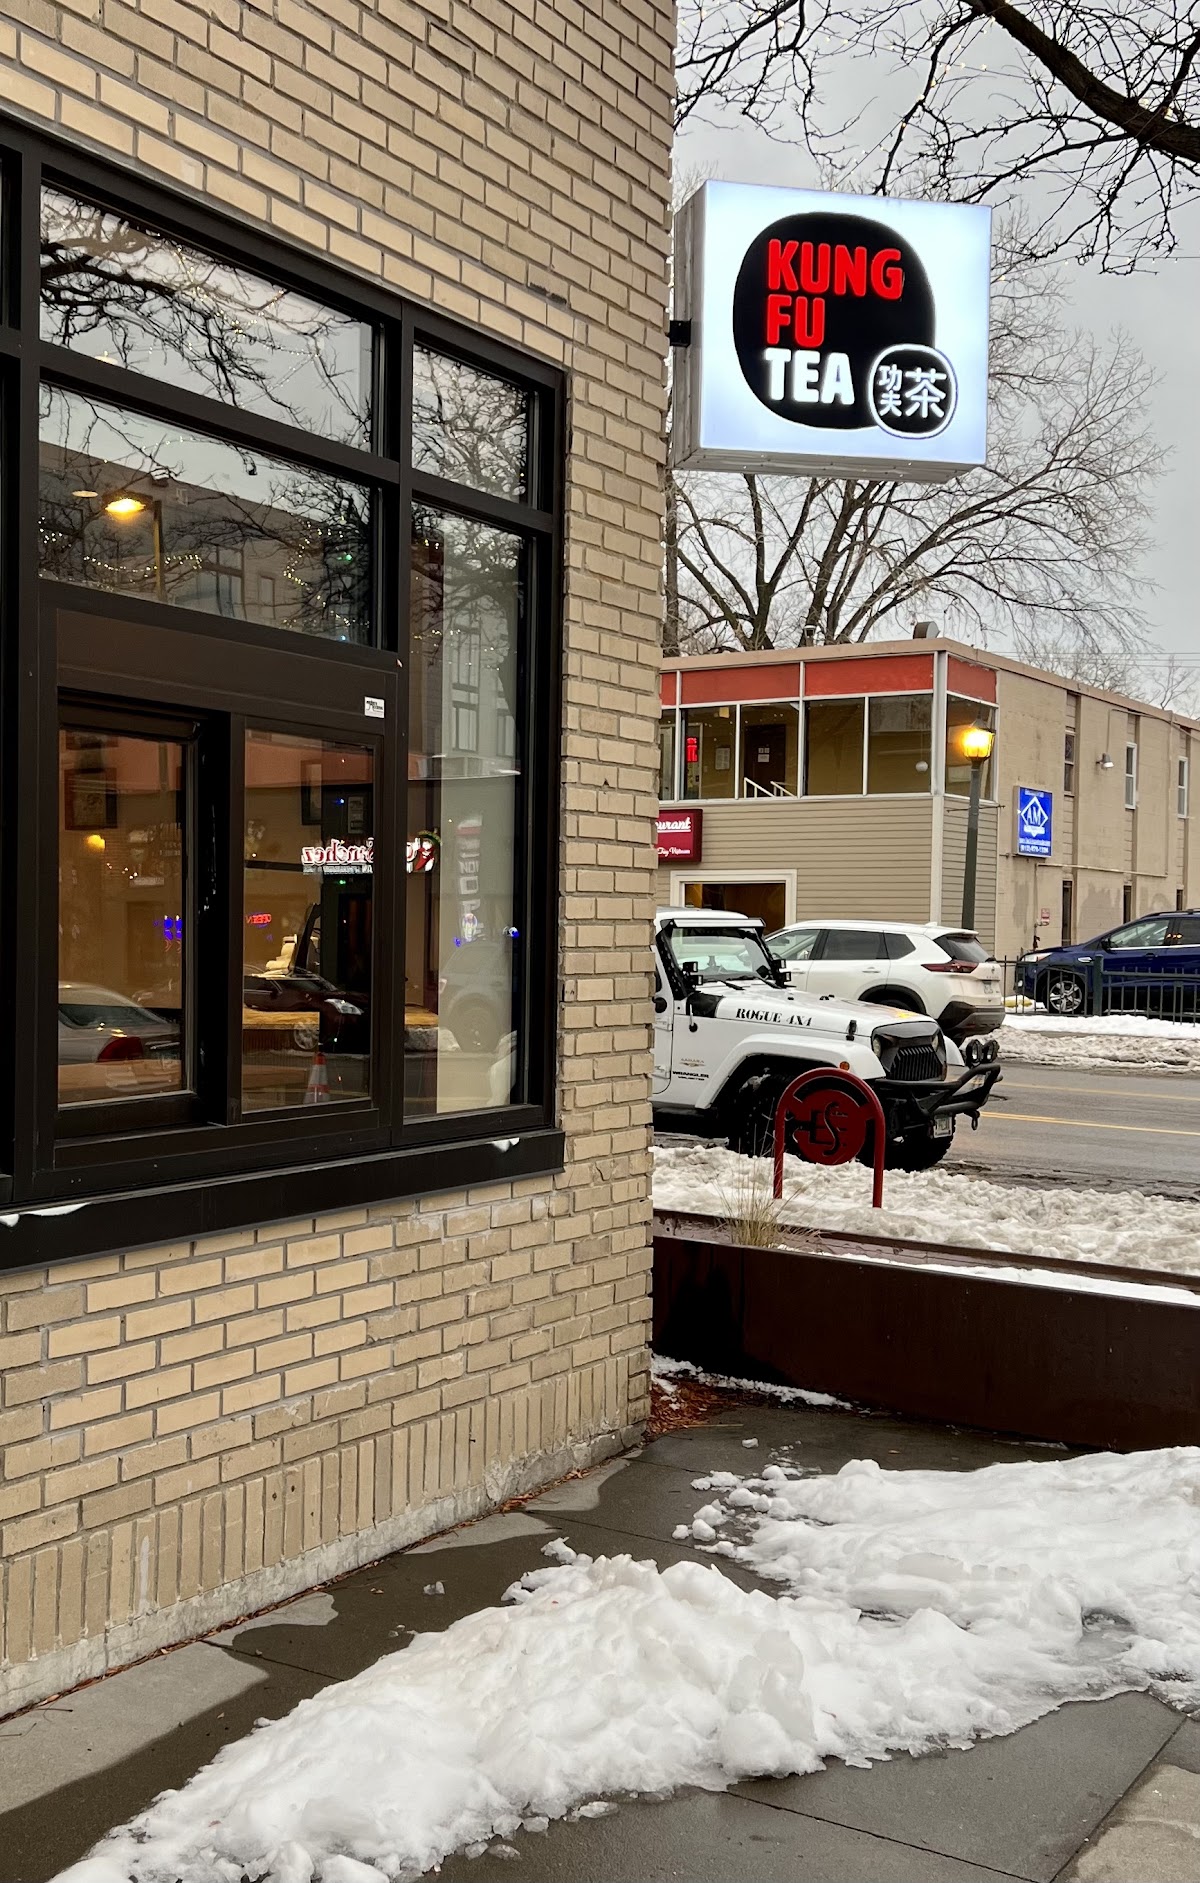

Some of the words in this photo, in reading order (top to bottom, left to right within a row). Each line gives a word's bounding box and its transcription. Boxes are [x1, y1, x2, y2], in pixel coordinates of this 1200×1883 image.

[768, 239, 903, 300] KUNG
[767, 294, 825, 348] FU
[764, 347, 855, 405] TEA
[736, 1008, 783, 1023] ROGUE
[786, 1015, 812, 1027] 4X4
[672, 1070, 709, 1079] WRANGLER
